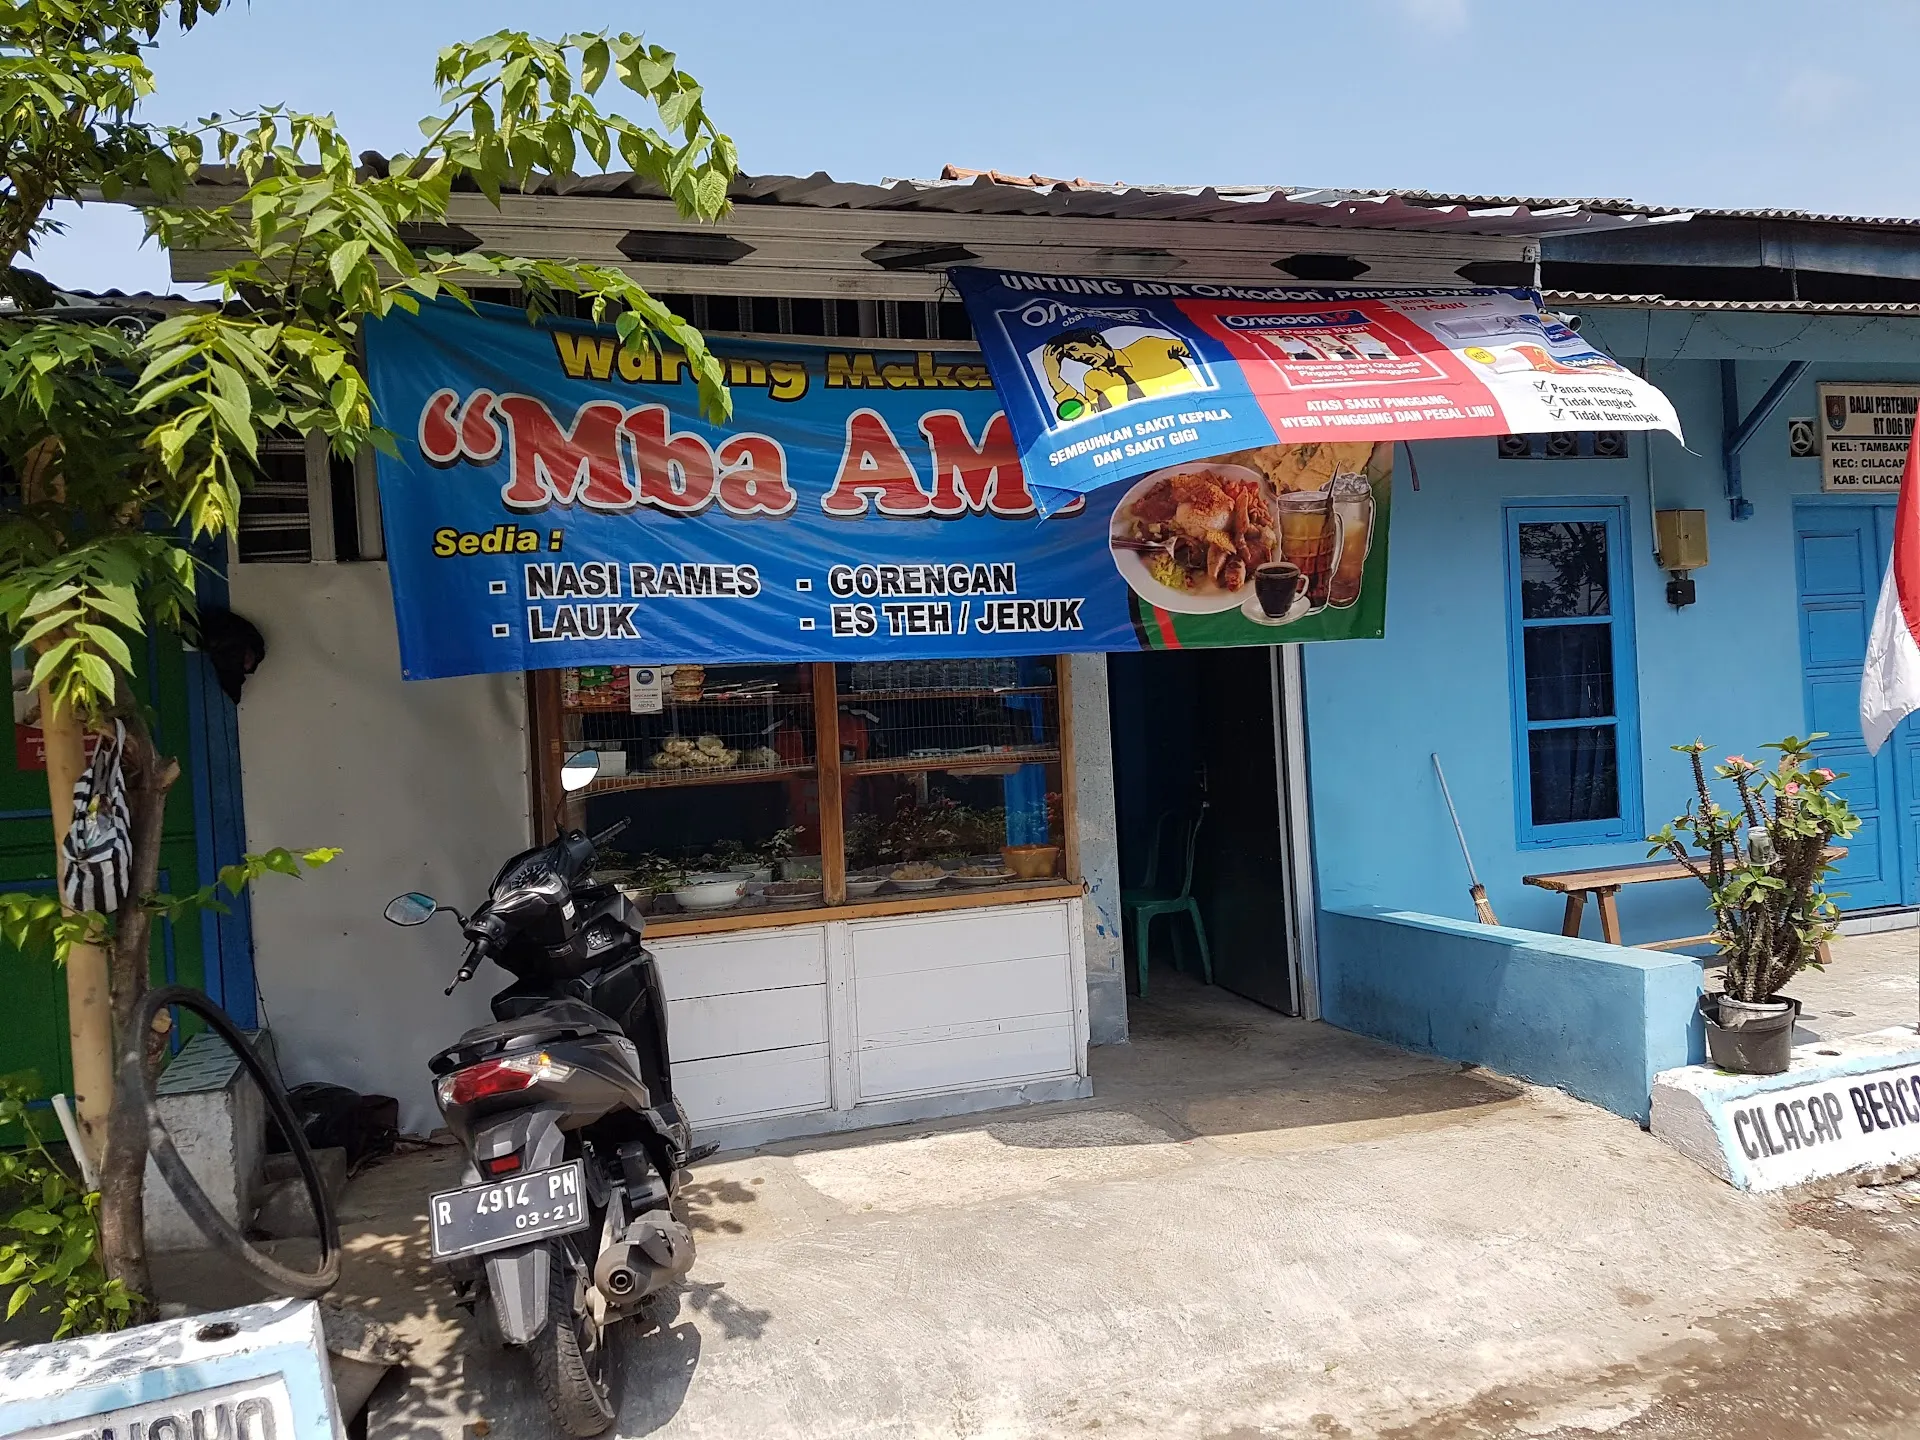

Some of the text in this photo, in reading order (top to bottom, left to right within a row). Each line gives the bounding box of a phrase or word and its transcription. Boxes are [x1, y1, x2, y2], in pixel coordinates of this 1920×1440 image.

[1000, 274, 1123, 295] UNTUNG
[1132, 281, 1190, 297] ADA
[1062, 311, 1085, 328] obat
[551, 330, 809, 402] Warng
[1305, 395, 1453, 412] ATASI SAKIT PINGGANG,
[1551, 383, 1634, 397] Panas meresap
[1560, 396, 1637, 410] Tidak lengket
[1849, 396, 1874, 414] BALAI
[1280, 404, 1495, 429] NYERI PUNGGUNG DAN PEGAL LINU
[1569, 409, 1661, 423] Tidak berminyak
[1873, 417, 1884, 435] RT
[1885, 417, 1903, 435] 006
[1048, 408, 1232, 467] SEMBUHKAN SAKIT KEPALA
[1093, 428, 1198, 468] DAN SAKIT GIGI
[821, 407, 1085, 517] AM
[432, 523, 541, 558] Sedia
[524, 561, 621, 600] NASI
[629, 561, 763, 599] RAMES
[828, 562, 1017, 599] GORENGAN
[527, 603, 641, 643] LAUK
[830, 603, 877, 637] ES
[882, 601, 952, 636] TEH
[957, 601, 971, 635] /
[975, 598, 1086, 634] JERUK
[1733, 1092, 1844, 1160] CILACAP
[439, 1171, 576, 1225] R 4914 PN
